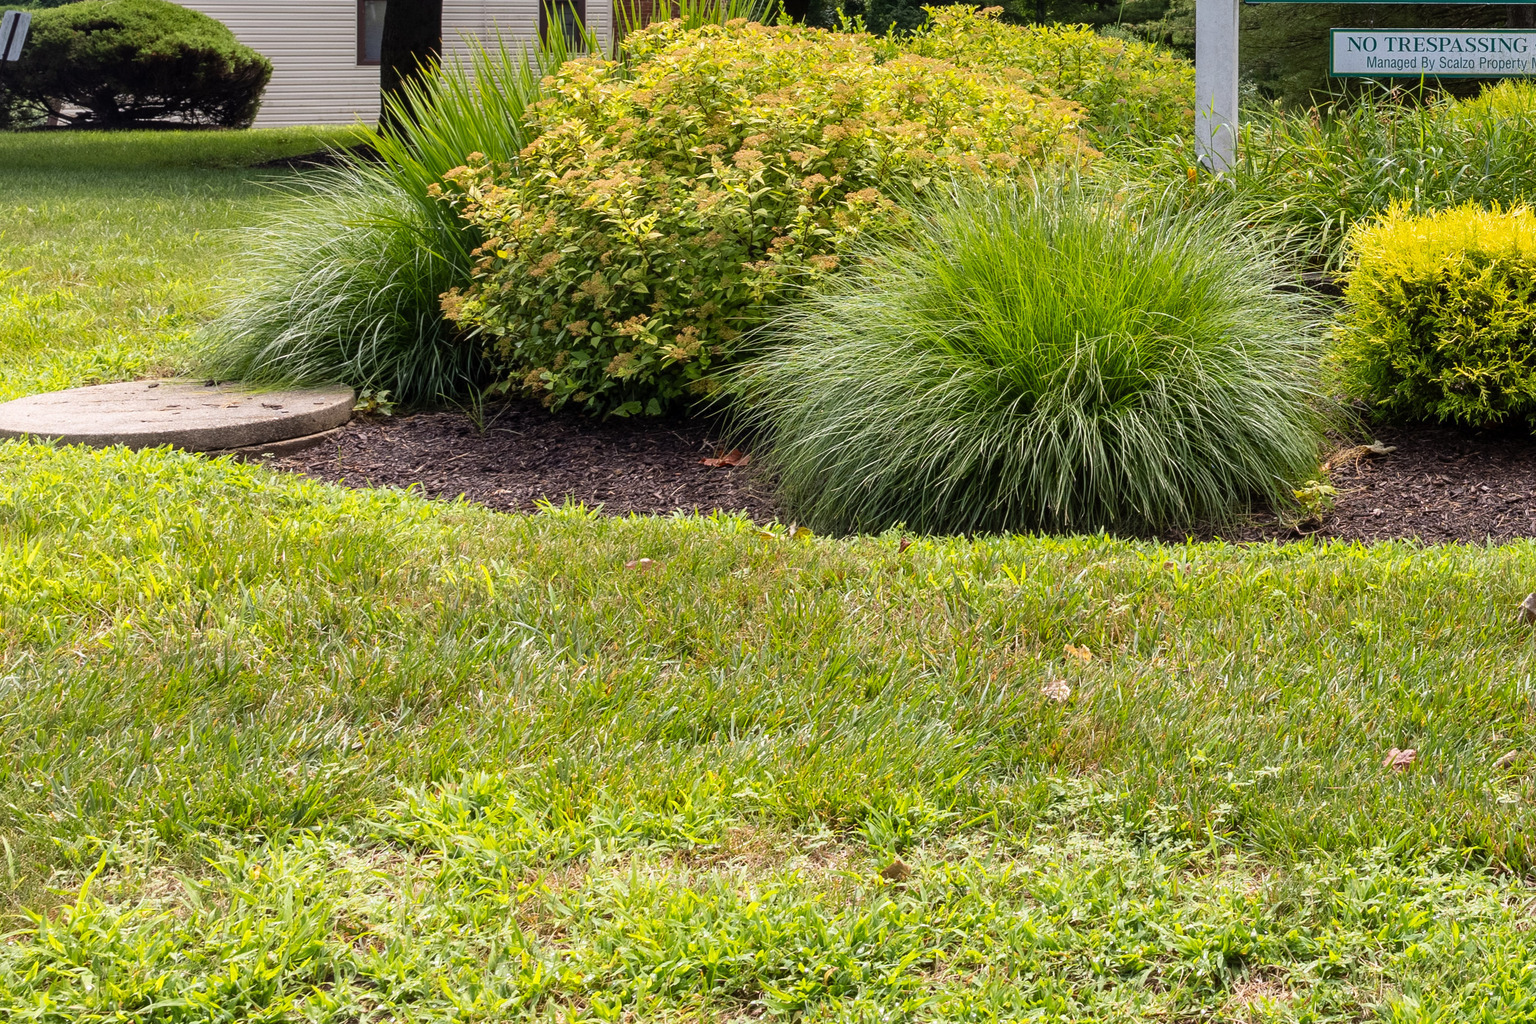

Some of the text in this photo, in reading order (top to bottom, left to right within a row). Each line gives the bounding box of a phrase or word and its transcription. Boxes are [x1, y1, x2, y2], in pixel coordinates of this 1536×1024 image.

[1347, 36, 1377, 53] NO
[1384, 36, 1528, 53] TRESPASSING
[1366, 56, 1417, 71] Managed
[1421, 56, 1435, 71] By
[1439, 56, 1475, 69] Scalzo
[1479, 57, 1528, 71] Property
